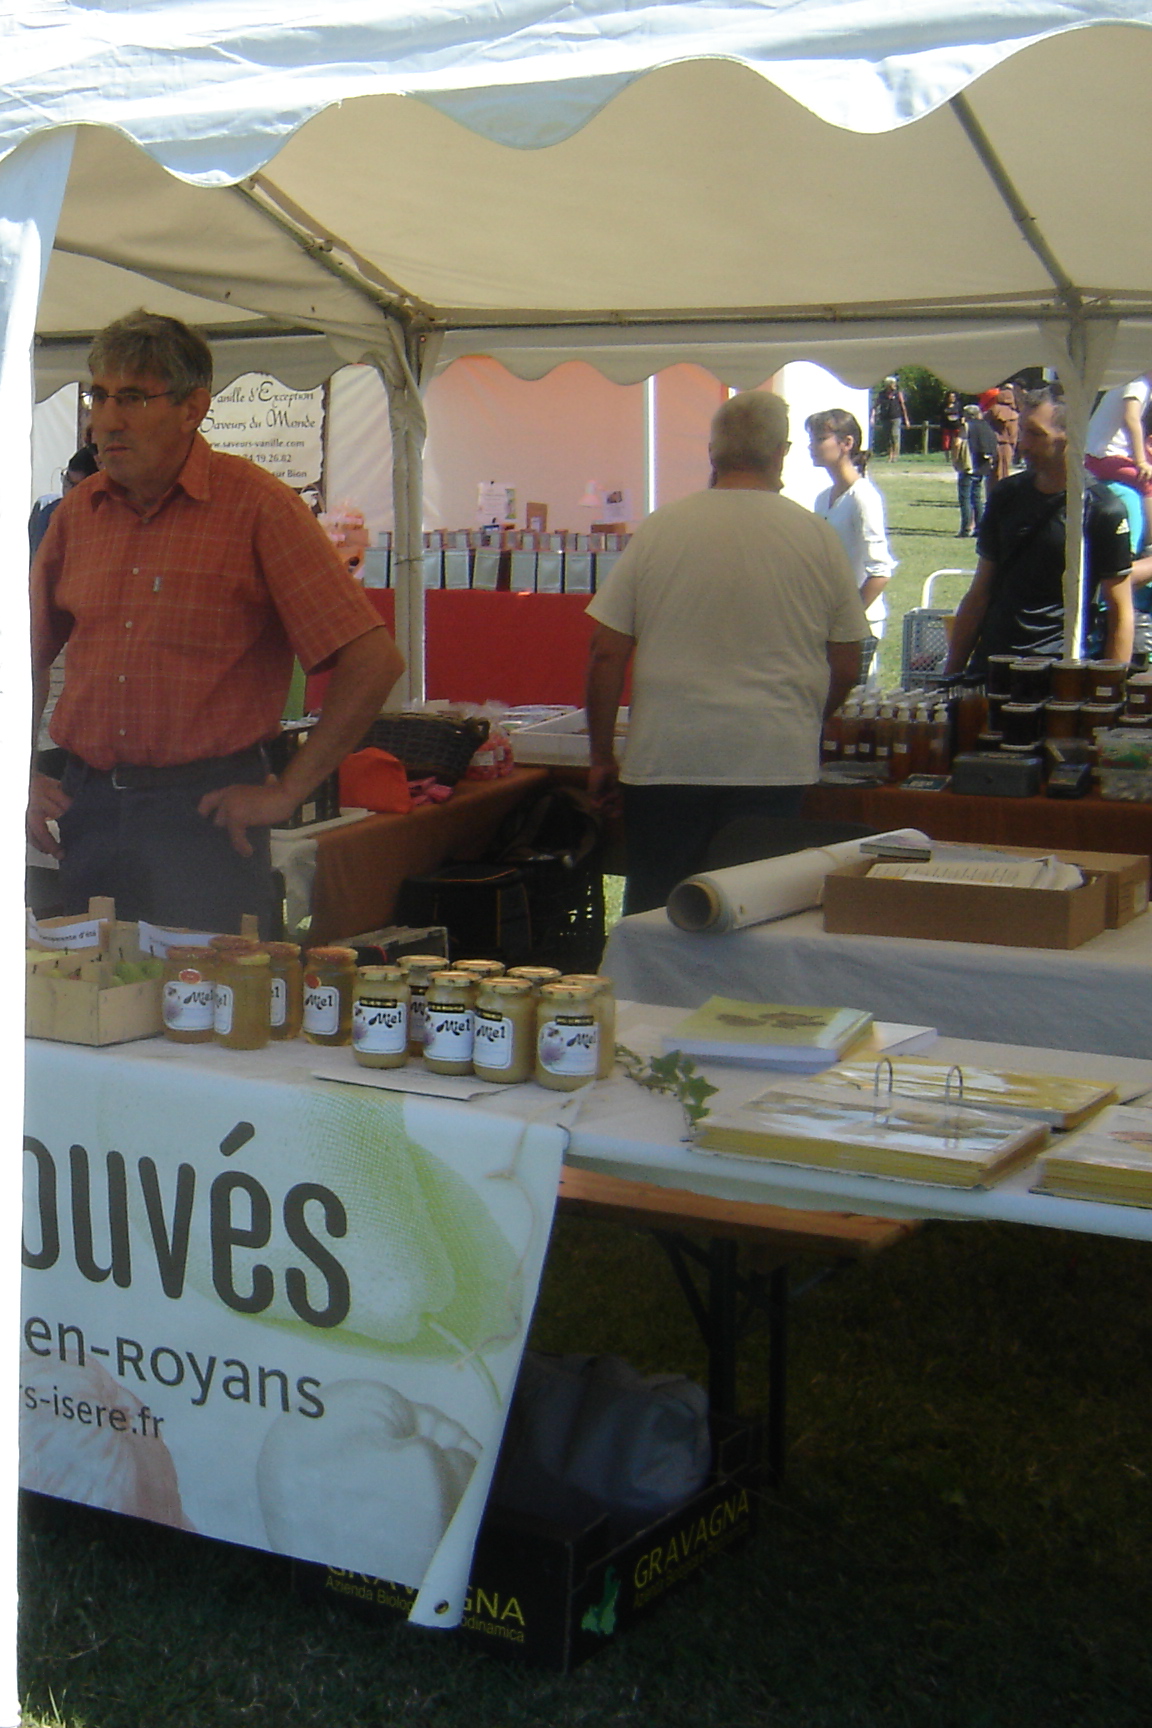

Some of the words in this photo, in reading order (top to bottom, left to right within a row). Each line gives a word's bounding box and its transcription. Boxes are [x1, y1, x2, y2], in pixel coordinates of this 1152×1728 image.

[212, 386, 244, 403] anille
[249, 415, 261, 428] du
[266, 409, 316, 428] Monde
[304, 992, 333, 1010] Miel
[368, 1010, 402, 1028] Miel
[435, 1018, 470, 1036] Miel
[476, 1025, 506, 1042] Miel
[566, 1031, 597, 1049] Miel
[634, 1488, 749, 1589] GRAVAGNA
[461, 1614, 525, 1643] odinamica
